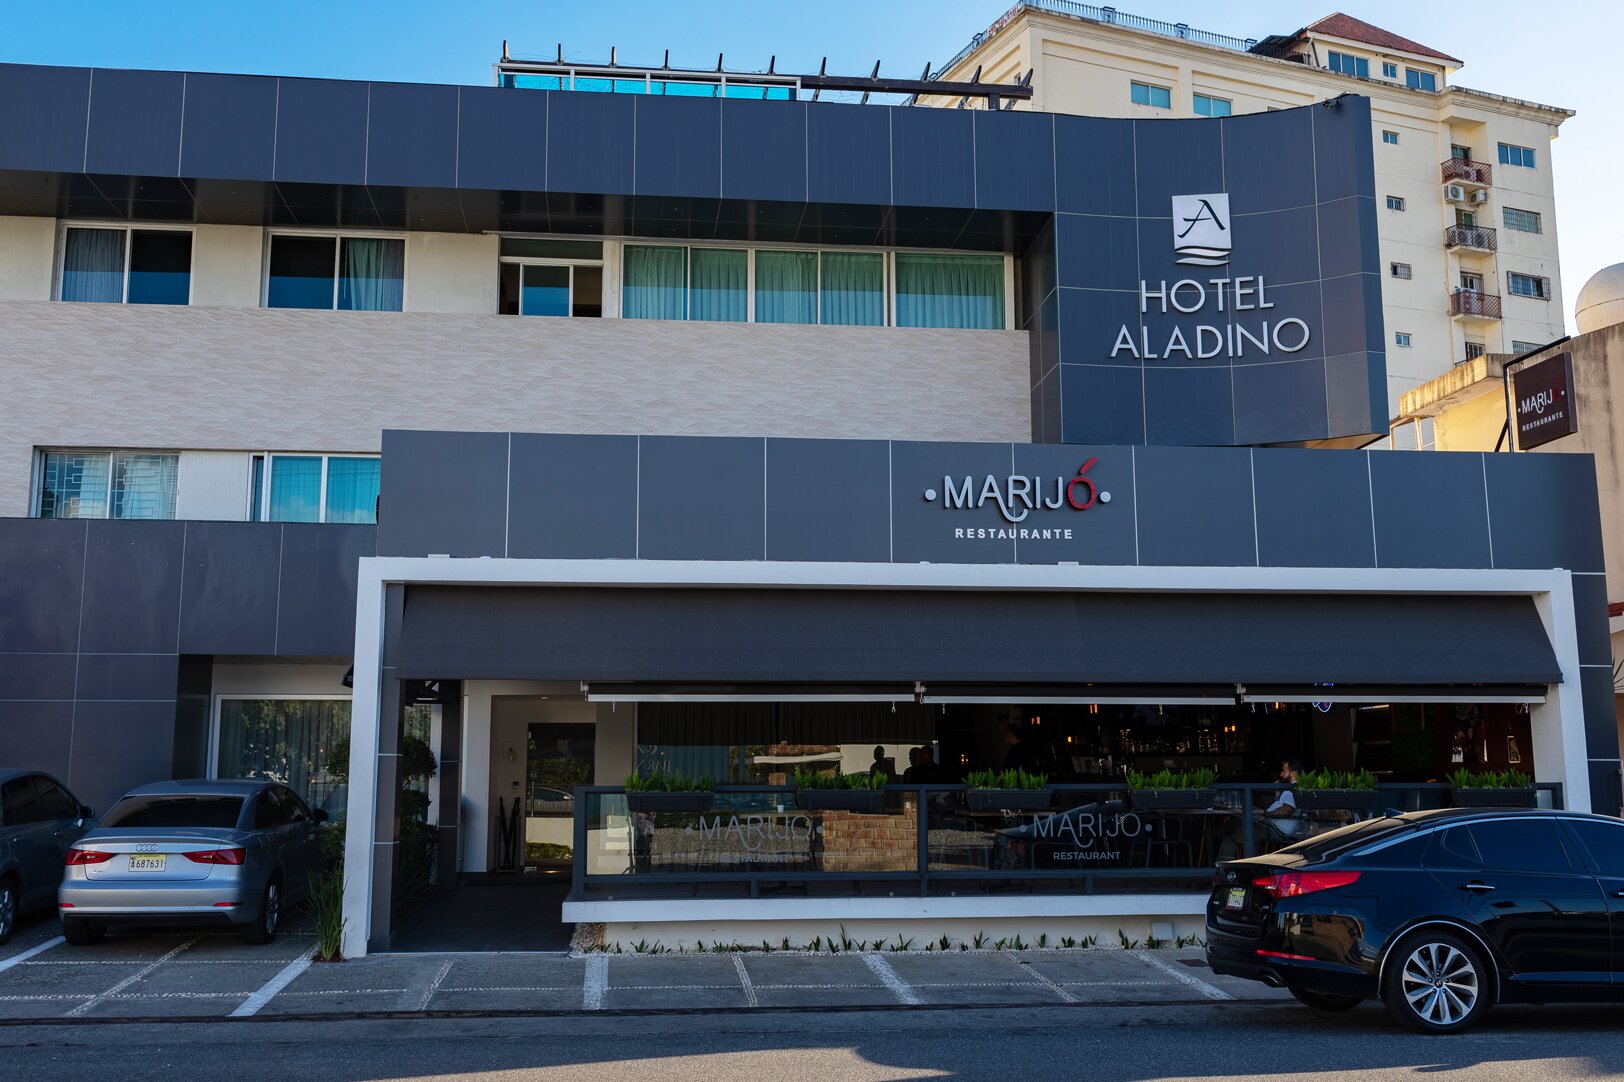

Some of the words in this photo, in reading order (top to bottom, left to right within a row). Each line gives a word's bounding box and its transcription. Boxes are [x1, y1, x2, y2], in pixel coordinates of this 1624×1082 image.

[1141, 275, 1275, 313] HOTEL
[1110, 317, 1310, 359] ALADINO
[1522, 411, 1564, 432] RESTAURANTE
[943, 456, 1098, 522] MARIJÓ
[955, 528, 1073, 540] RESTAURANTE
[1033, 813, 1142, 848] MARIJO
[719, 854, 789, 863] RESTAURANT
[1053, 851, 1121, 860] RESTAURANT
